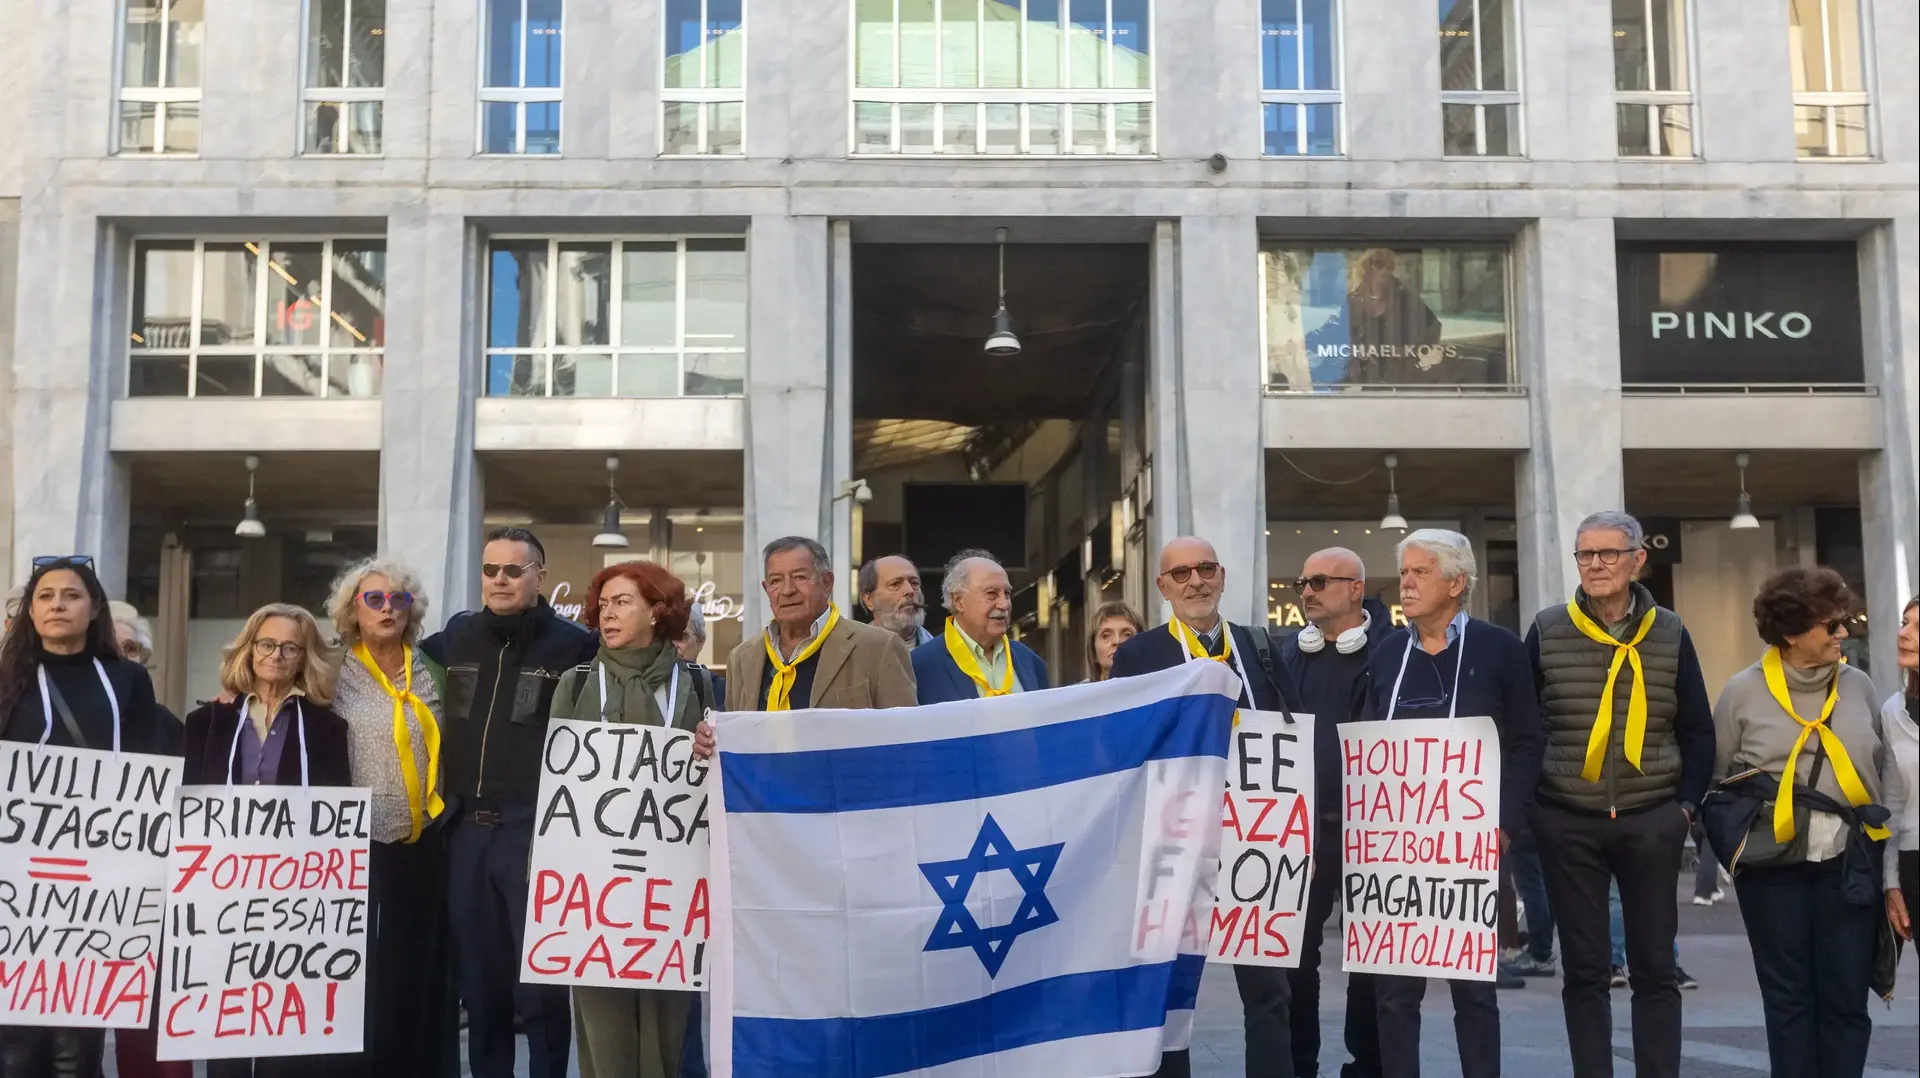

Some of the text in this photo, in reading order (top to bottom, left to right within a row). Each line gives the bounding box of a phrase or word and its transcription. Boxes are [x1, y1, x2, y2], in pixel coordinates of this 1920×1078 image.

[1651, 311, 1812, 339] PINKO
[1317, 343, 1457, 358] MICHAEL KORS
[550, 581, 583, 622] Spag
[6, 750, 171, 805] IVILI IN
[545, 725, 709, 787] OSTAGG
[1224, 732, 1298, 794] EE
[1343, 737, 1482, 777] HOUTHI
[179, 796, 368, 839] PRIMA DEL
[538, 784, 710, 846] A CASA
[1345, 779, 1485, 825] HAMAS
[0, 798, 171, 858] STAGGIO
[1344, 827, 1500, 872] HEZBOLLAH
[172, 845, 368, 893] 7 OTTOBRE
[0, 880, 162, 926] RIMINE
[172, 897, 366, 938] IL CESSATE
[533, 869, 710, 940] PACE A
[0, 924, 151, 961] ONTRO
[171, 940, 362, 993] IL FUOCO
[527, 931, 705, 988] GAZA!
[1346, 920, 1497, 976] AYATOLLAH
[0, 951, 156, 1024] MANITÀ
